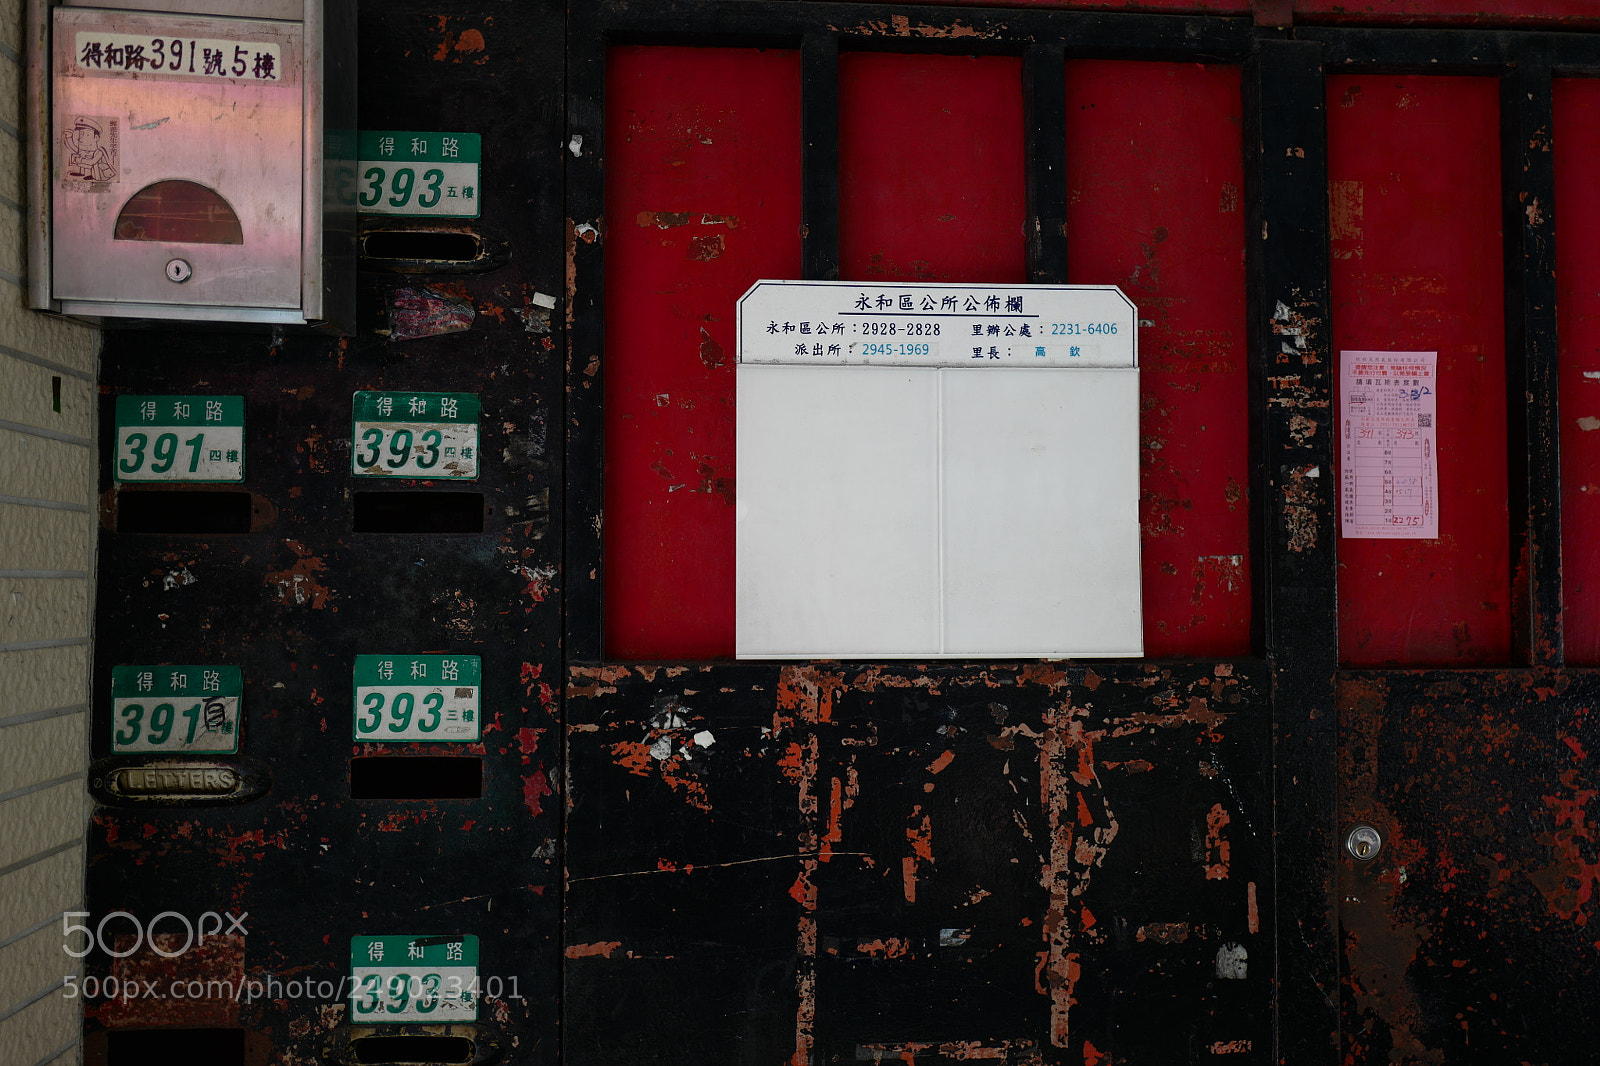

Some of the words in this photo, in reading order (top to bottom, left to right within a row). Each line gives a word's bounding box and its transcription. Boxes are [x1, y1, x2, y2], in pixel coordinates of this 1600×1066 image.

[81, 38, 276, 80] 得和路391號5樓
[379, 137, 459, 158] 得和路
[360, 167, 445, 208] 393
[446, 186, 475, 199] 五樓
[854, 293, 1024, 313] 永和區公所公佈欄
[1051, 323, 1118, 335] 2231-6406
[862, 343, 929, 355] 2945-1969
[140, 401, 223, 421] 得和路
[376, 396, 458, 419] 得和路
[120, 433, 205, 473] 391
[209, 449, 239, 463] 四樓
[357, 428, 443, 469] 393
[444, 447, 473, 460] 四樓
[137, 670, 220, 692] 得和路
[377, 660, 459, 681] 得和路
[116, 703, 202, 745] 391
[358, 693, 445, 733] 393
[446, 709, 475, 722] 三樓
[127, 770, 235, 788] LETTERS
[367, 941, 463, 962] 得和路
[356, 973, 442, 1014] 393
